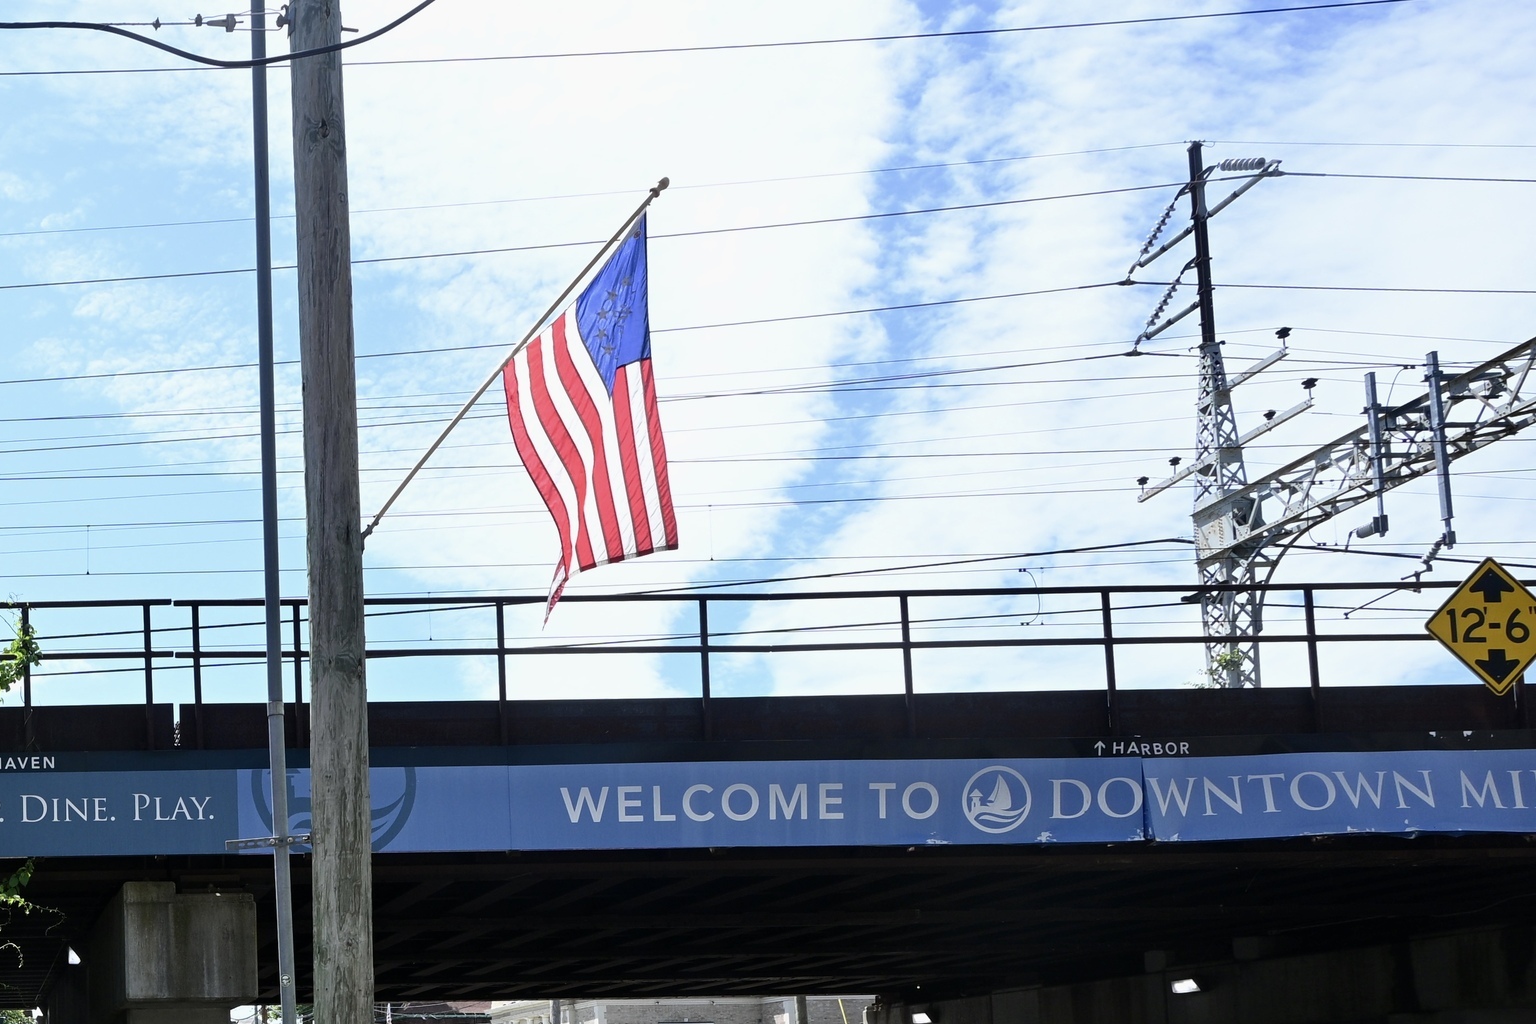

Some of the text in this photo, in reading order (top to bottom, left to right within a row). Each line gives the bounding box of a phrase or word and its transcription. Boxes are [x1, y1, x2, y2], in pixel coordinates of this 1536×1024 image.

[1112, 741, 1190, 756] HARBOR
[560, 781, 940, 824] WELCOME TO
[1049, 769, 1536, 820] DOWNTOWN MI
